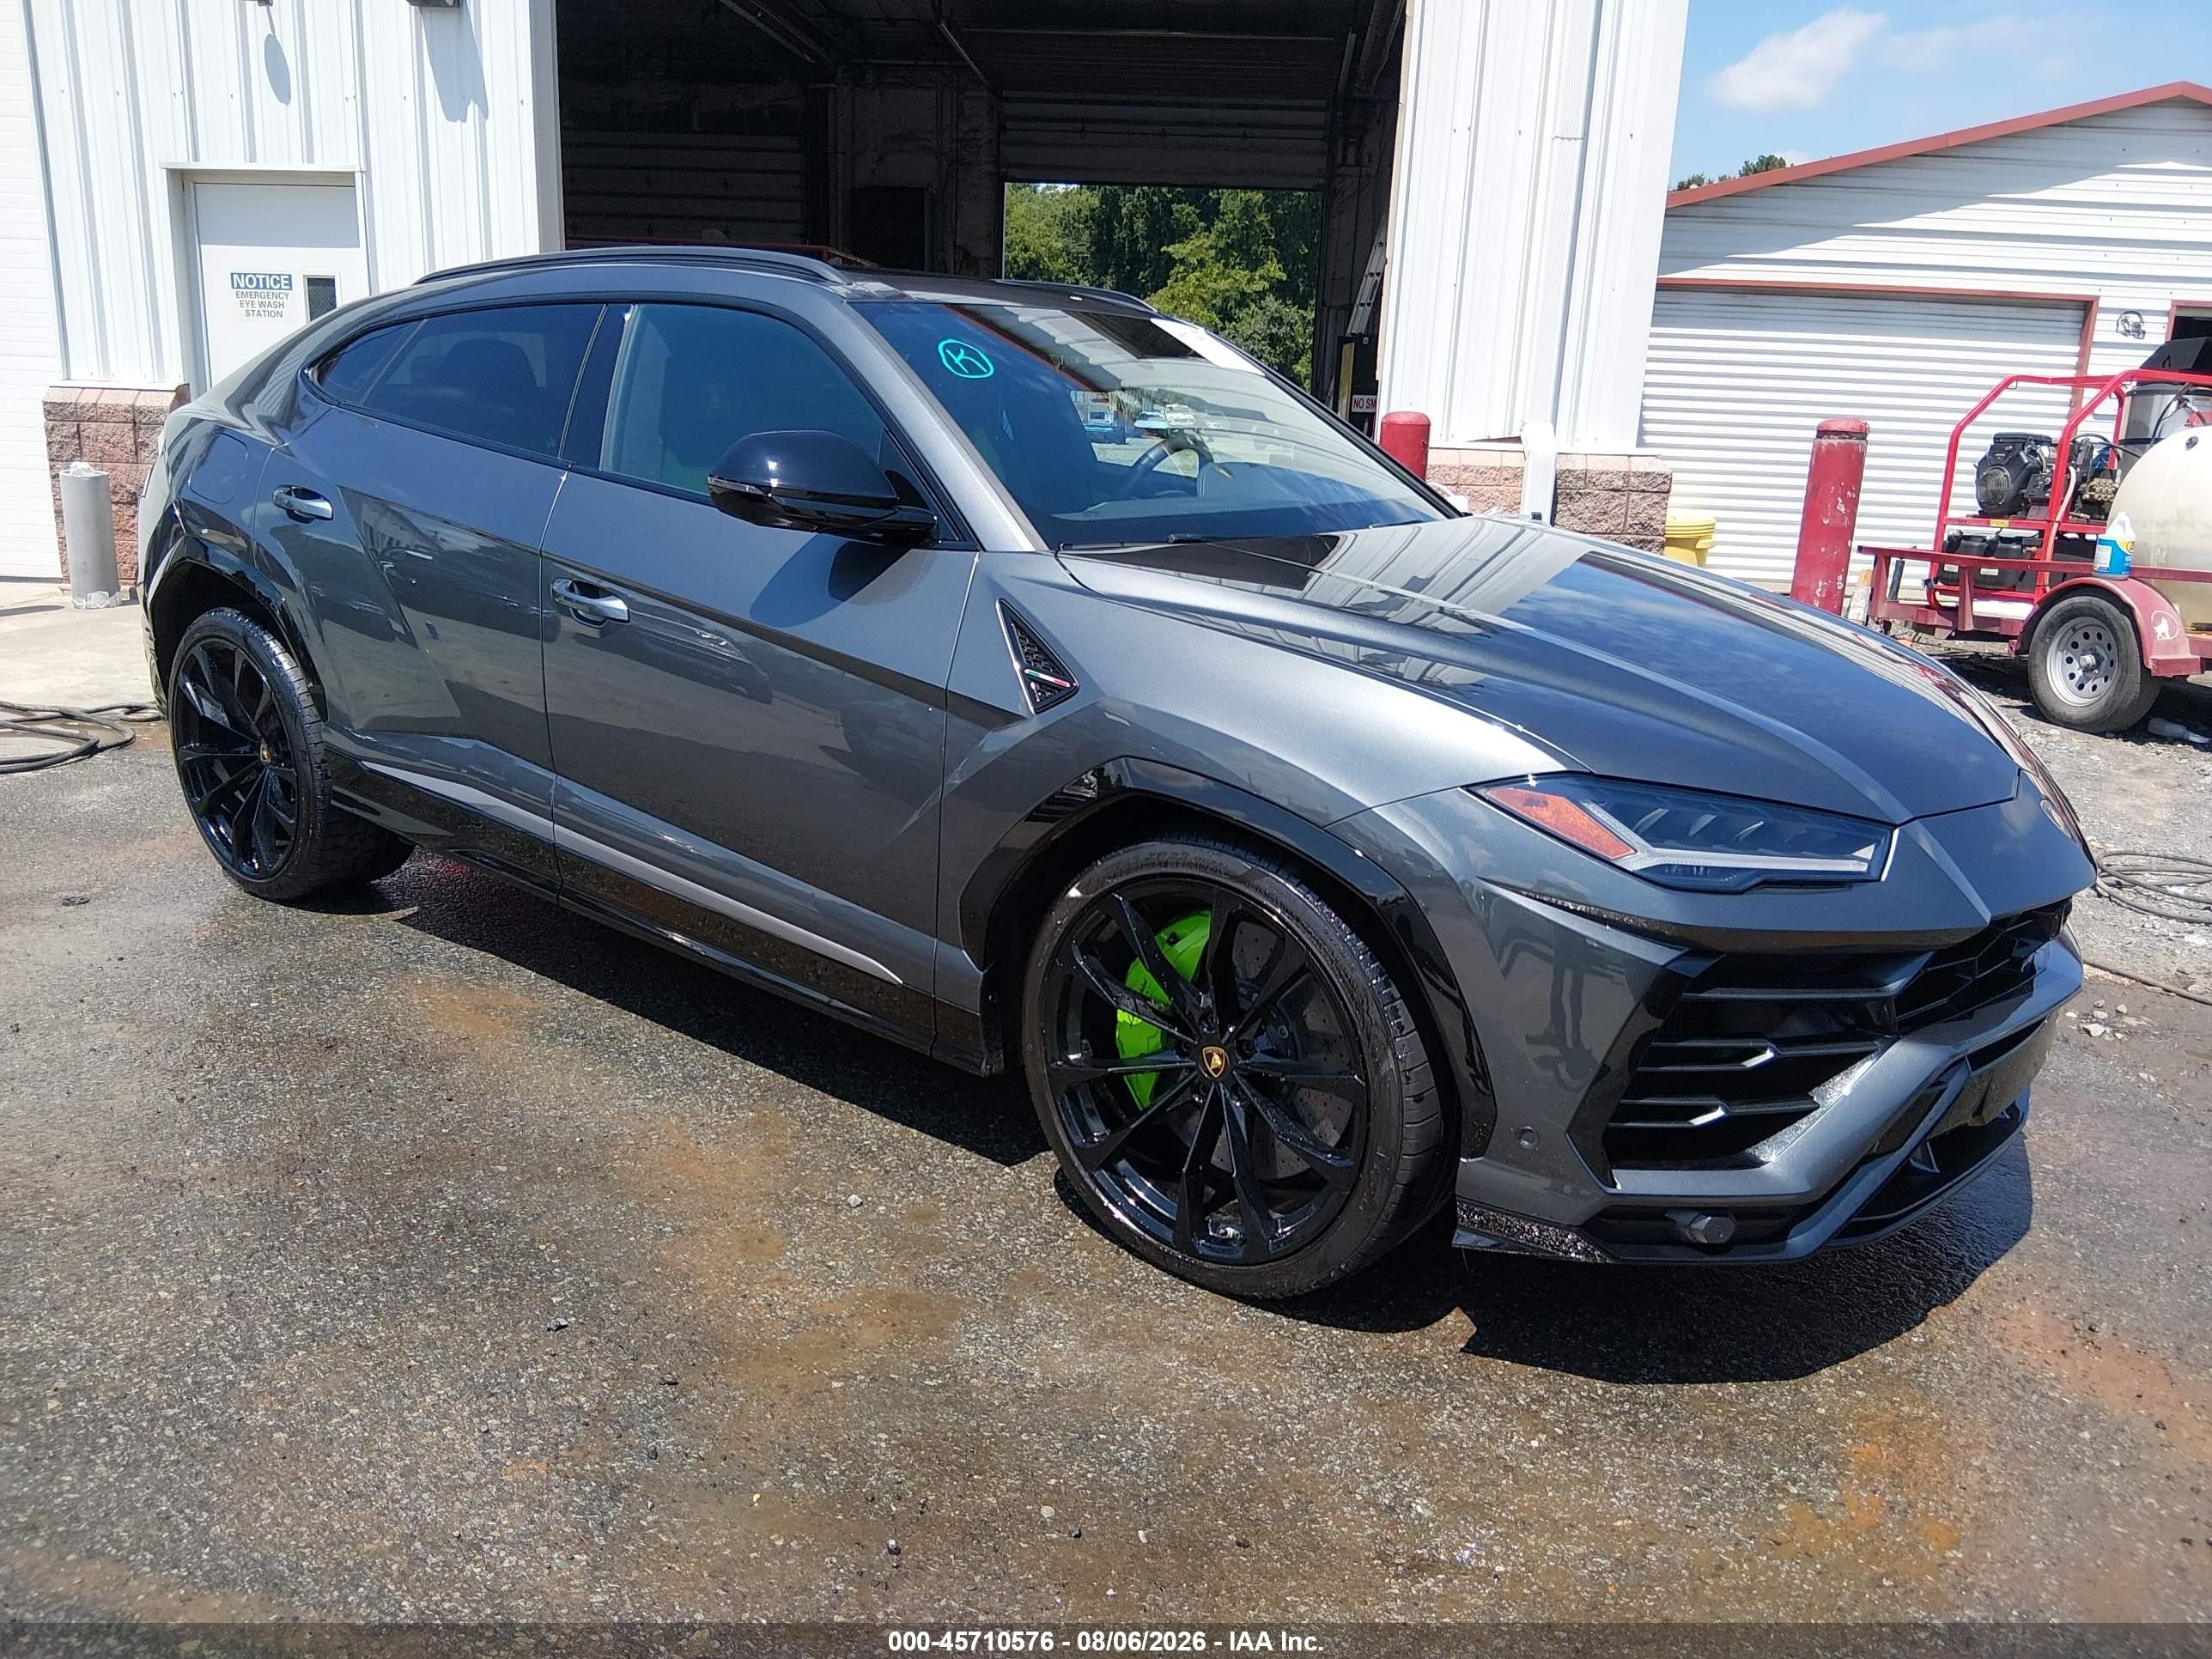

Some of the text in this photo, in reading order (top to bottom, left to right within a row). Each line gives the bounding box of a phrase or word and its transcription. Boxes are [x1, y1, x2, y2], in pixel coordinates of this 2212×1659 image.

[233, 274, 290, 289] NOTICE
[235, 290, 289, 300] EMERGENCY
[240, 300, 285, 309] EYE WASH
[245, 309, 283, 318] STATION
[945, 347, 988, 374] K
[1353, 398, 1364, 409] NO
